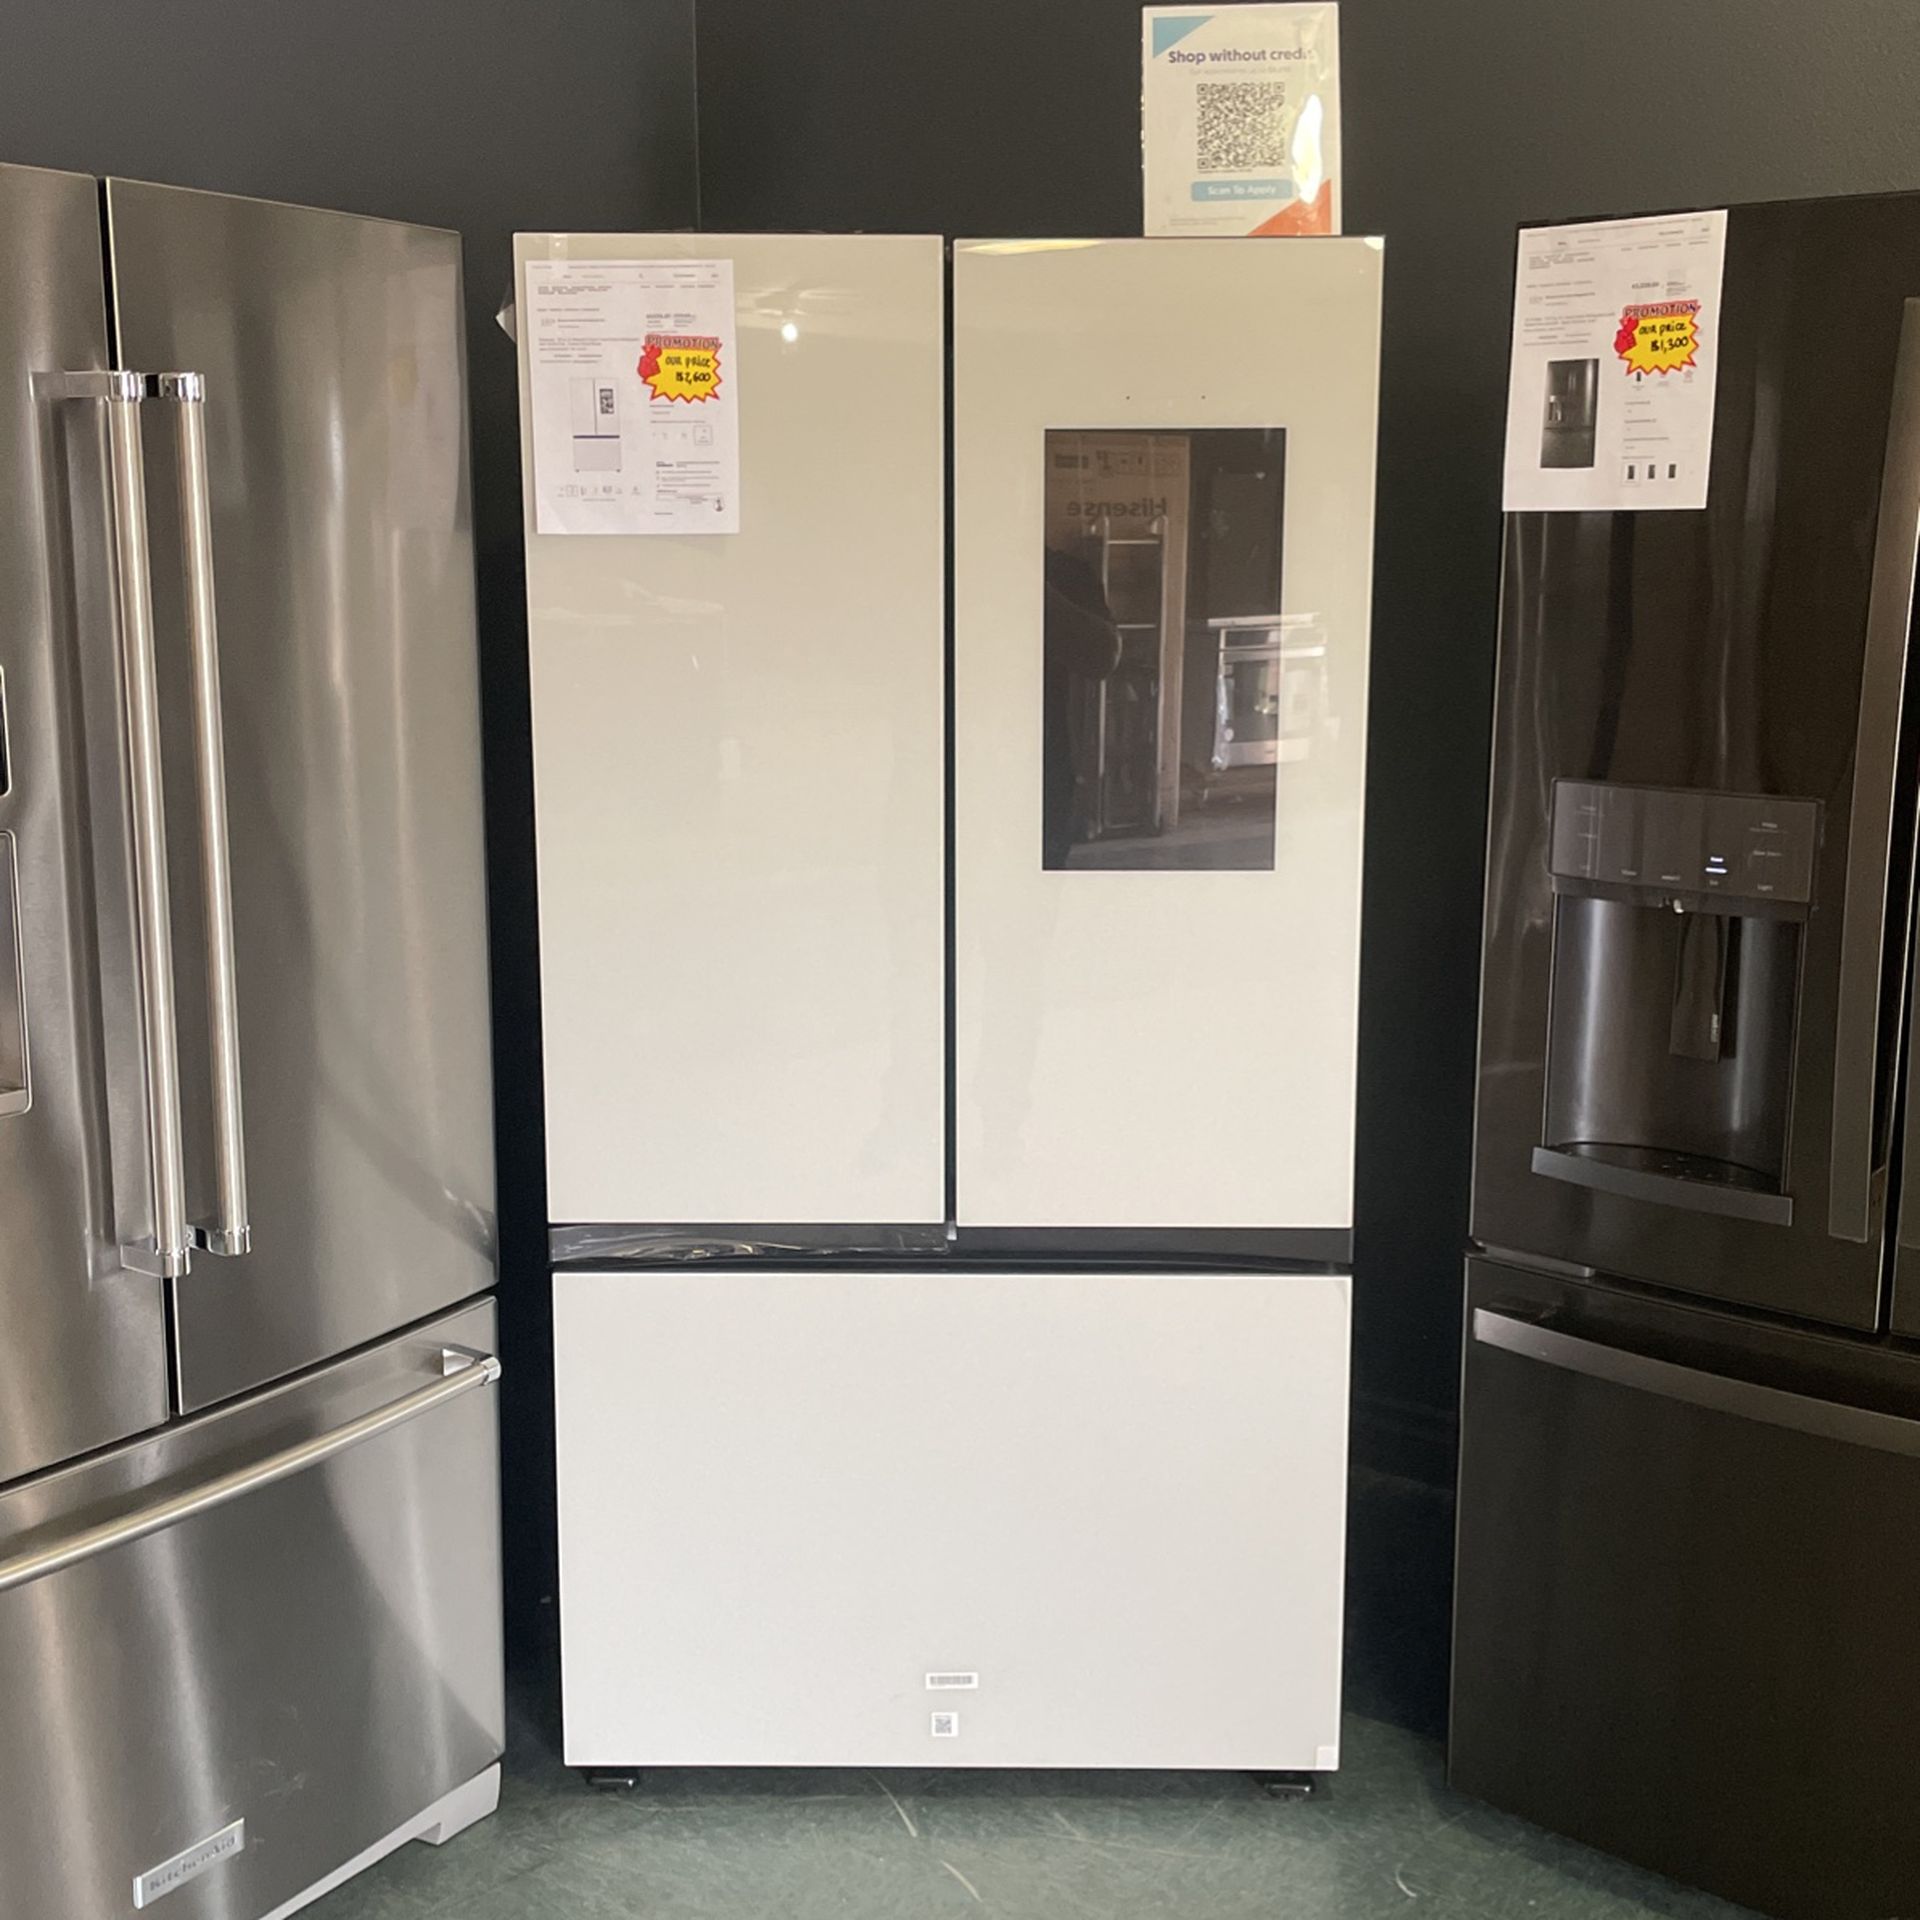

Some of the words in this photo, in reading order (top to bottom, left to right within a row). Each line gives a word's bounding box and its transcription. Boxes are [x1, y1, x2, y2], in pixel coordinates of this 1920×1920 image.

[1168, 50, 1206, 65] Shop
[1209, 49, 1266, 61] without
[1207, 186, 1231, 195] Scan
[1247, 184, 1276, 196] Apply
[1624, 303, 1697, 317] PROMOTION
[645, 335, 719, 350] PROMOTION
[1651, 336, 1689, 354] $1,300
[150, 1836, 236, 1891] KitchenAid
